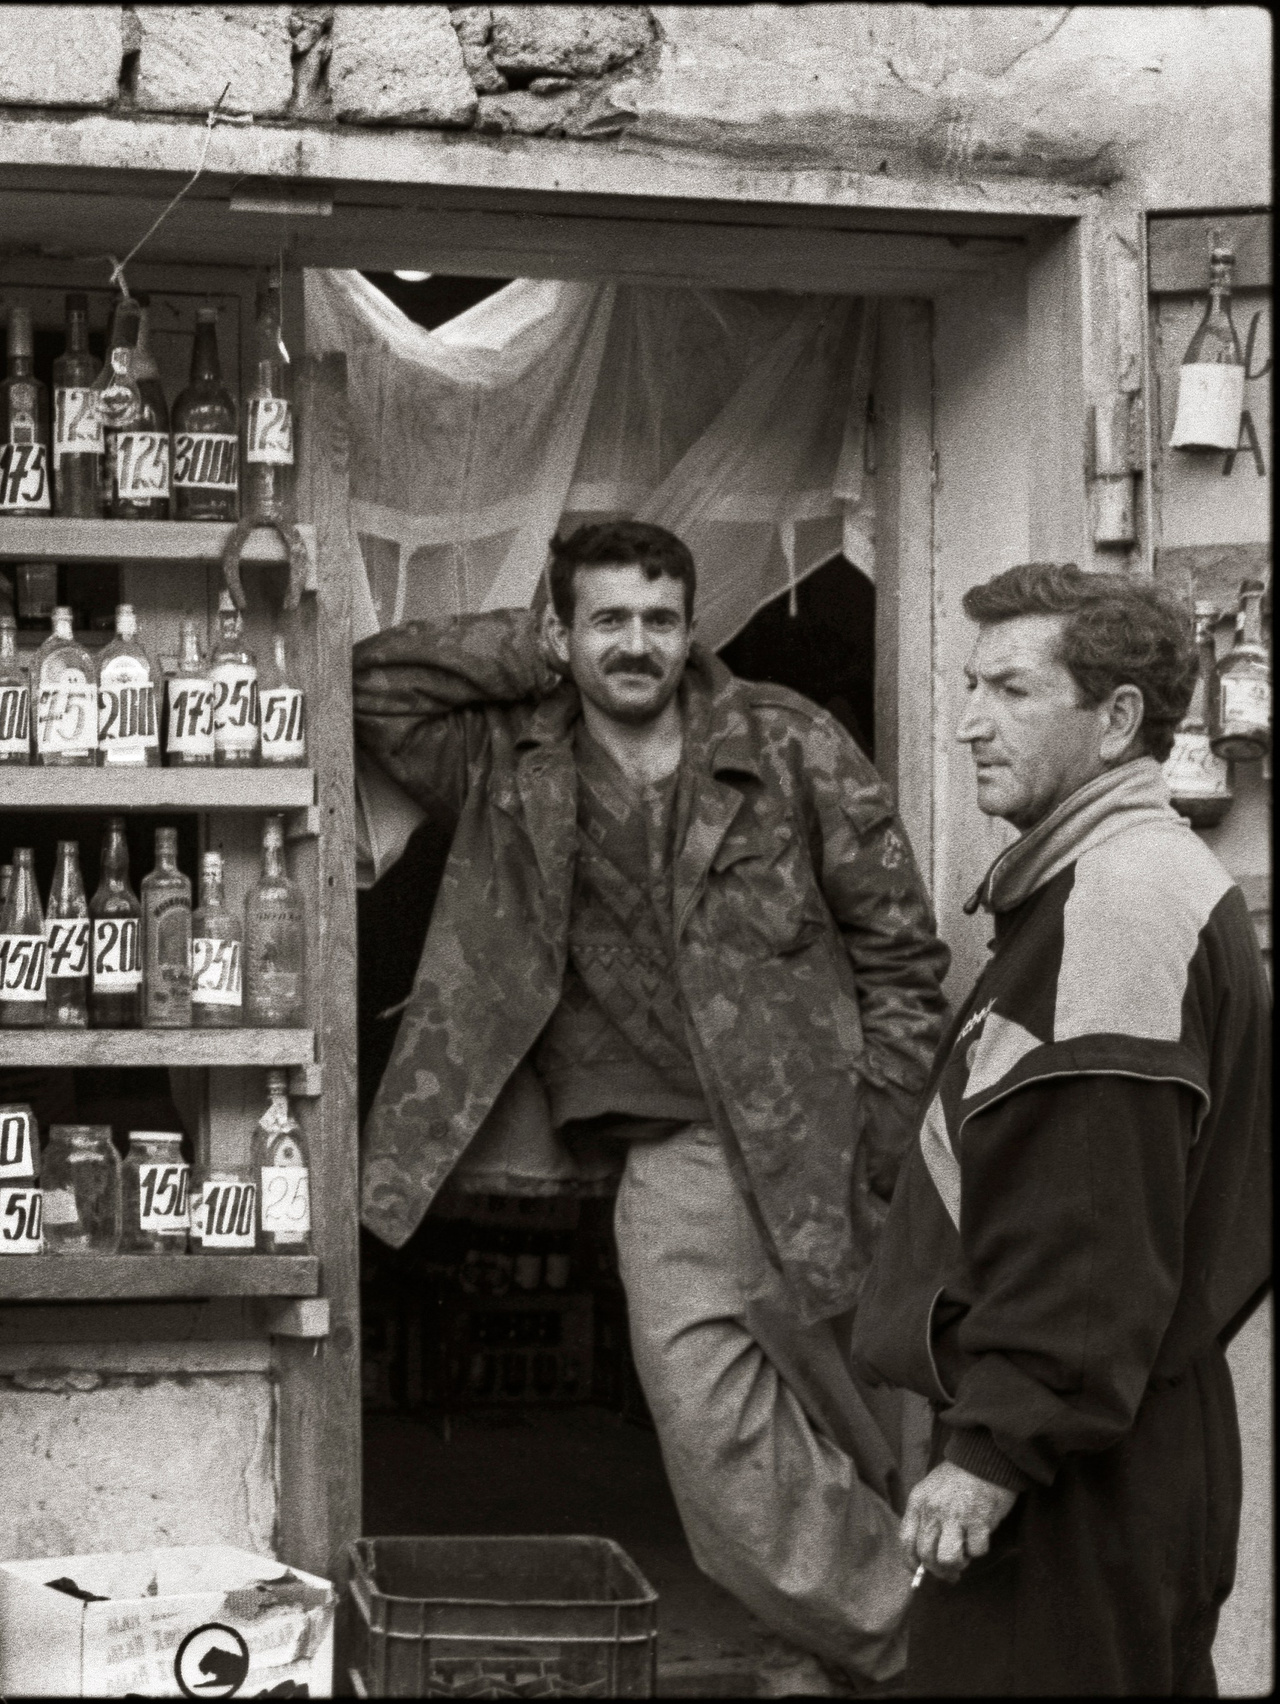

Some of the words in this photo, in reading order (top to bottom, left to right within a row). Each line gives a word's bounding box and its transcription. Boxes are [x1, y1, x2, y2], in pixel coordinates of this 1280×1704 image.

[120, 435, 169, 490] 125
[263, 695, 304, 742] 50
[0, 940, 46, 991] 150
[48, 924, 90, 975] 75
[3, 1193, 42, 1240] 50
[141, 1167, 189, 1217] 150
[205, 1185, 255, 1236] 100
[265, 1175, 309, 1221] 25
